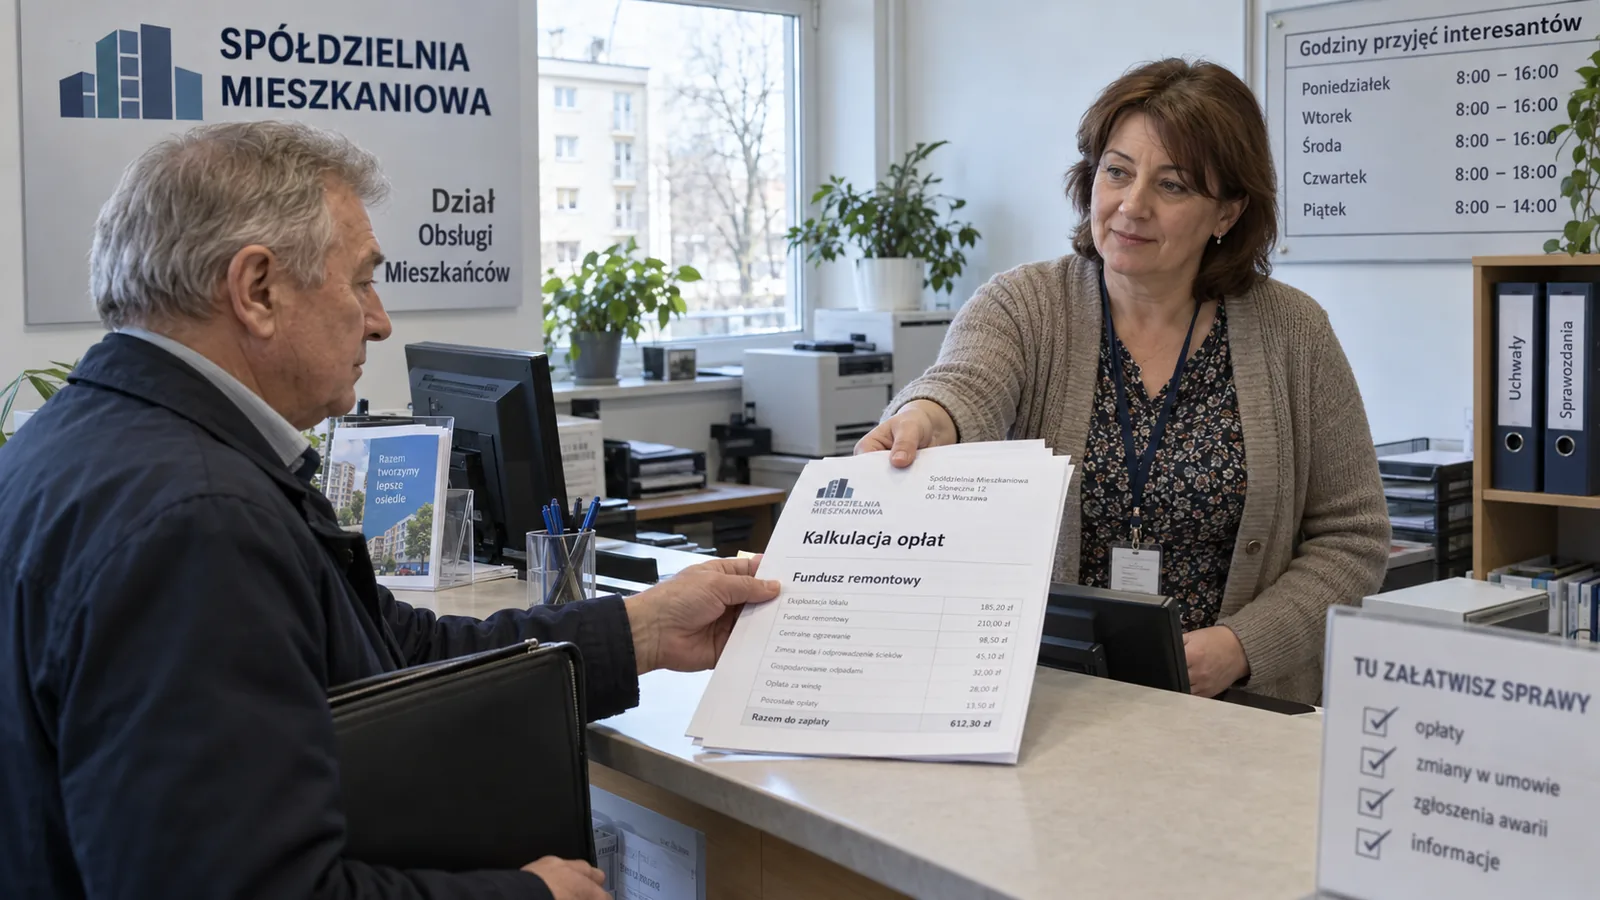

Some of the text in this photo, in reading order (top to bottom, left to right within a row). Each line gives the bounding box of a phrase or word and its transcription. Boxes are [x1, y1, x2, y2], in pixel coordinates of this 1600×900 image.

[1300, 13, 1582, 57] Godziny przyjęć interesantów
[220, 24, 470, 72] SPÓŁDZIELNIA
[1302, 76, 1390, 96] Poniedziałek
[1456, 69, 1490, 84] 8:00
[1514, 64, 1558, 80] 16:00
[221, 75, 492, 116] MIESZKANIOWA
[1302, 108, 1352, 125] Wtorek
[1456, 101, 1490, 116] 8:00
[1514, 97, 1558, 113] 16:00
[1302, 138, 1342, 153] Środa
[1455, 133, 1489, 148] 8:00
[1514, 130, 1557, 146] 16:00
[1303, 170, 1367, 185] Czwartek
[1455, 167, 1489, 181] 8:00
[1513, 164, 1557, 180] 18:00
[432, 188, 495, 213] Dział
[1303, 202, 1346, 220] Piątek
[1455, 200, 1489, 214] 8:00
[1513, 198, 1557, 213] 14:00
[419, 224, 492, 252] Obsługi
[385, 260, 510, 282] Mieszkańców
[1508, 336, 1526, 400] Uchwały
[1560, 320, 1576, 418] Sprawozdania
[379, 454, 406, 463] Razem
[378, 468, 420, 478] tworzymy
[376, 480, 403, 492] lepsze
[375, 494, 406, 504] osiedle
[802, 530, 945, 549] Kalkulacja opłat
[792, 572, 921, 588] Fundusz remontowy
[812, 615, 849, 624] remontowy
[779, 630, 810, 638] Centralne
[822, 649, 873, 658] odprowadzenie
[770, 662, 827, 672] Gospodarowanie
[1354, 656, 1591, 714] TU ZAŁATWISZ SPRAWY
[752, 713, 830, 727] Razem do zapłaty
[950, 720, 981, 728] 612,30
[1415, 720, 1464, 745] opłaty
[1416, 757, 1560, 797] zmiany w umowie
[1414, 796, 1548, 837] zgłoszenia awarii
[1411, 834, 1500, 873] informacje
